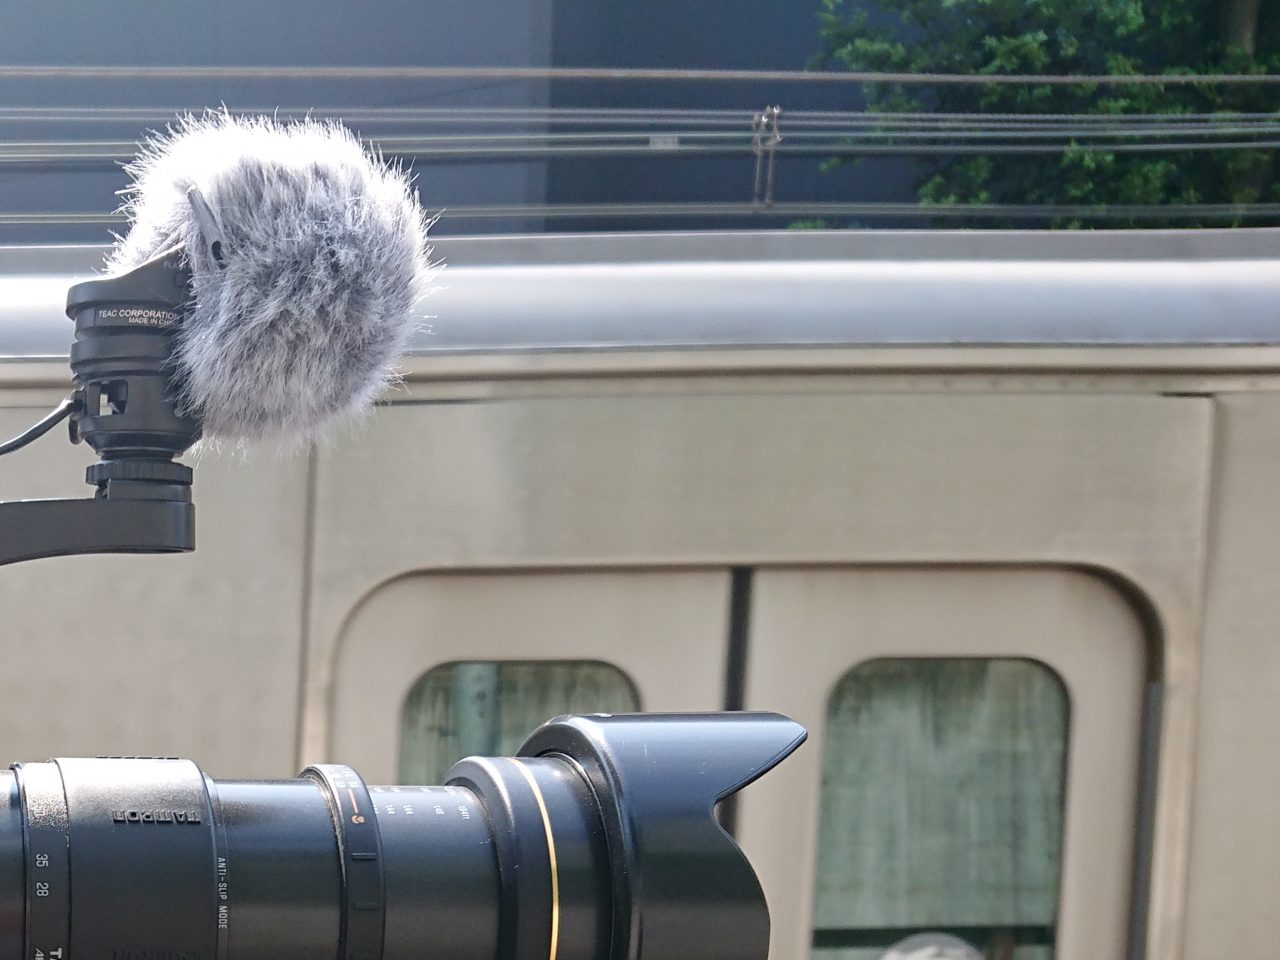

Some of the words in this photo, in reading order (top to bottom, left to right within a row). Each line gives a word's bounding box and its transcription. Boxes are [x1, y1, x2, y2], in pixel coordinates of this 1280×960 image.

[99, 310, 117, 318] TEAC
[36, 853, 48, 867] 35
[217, 857, 228, 900] ANTI-SLIP
[36, 882, 48, 897] 28
[218, 905, 228, 929] MODE
